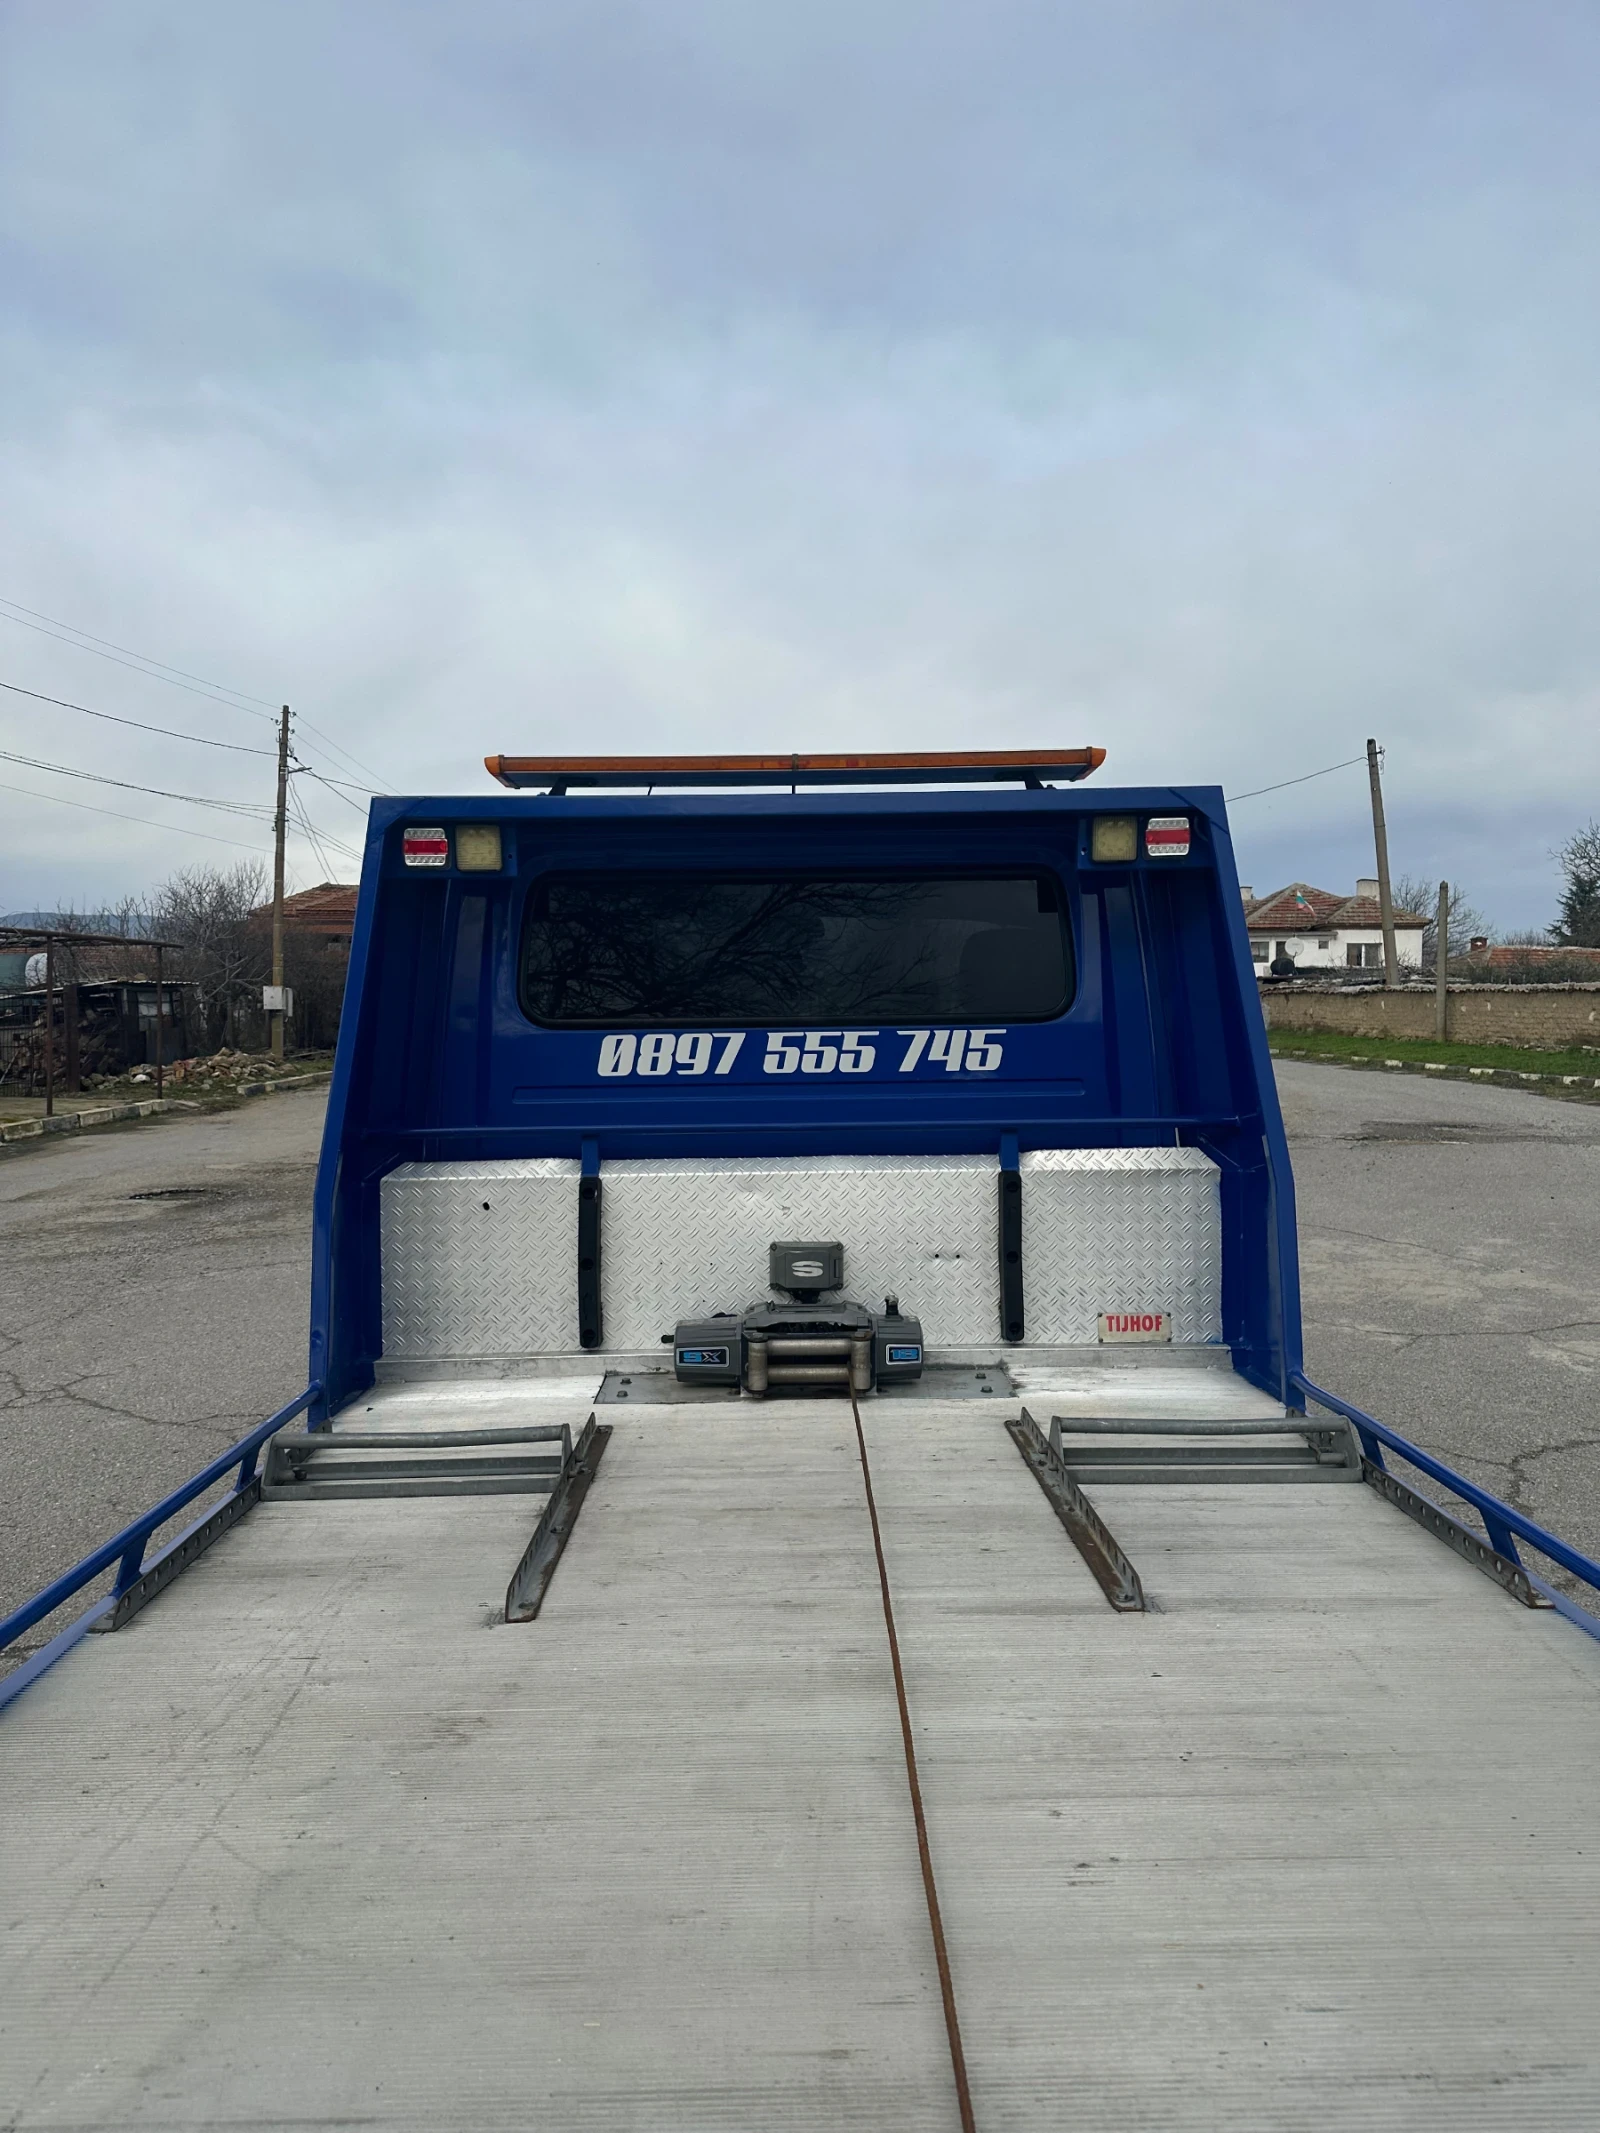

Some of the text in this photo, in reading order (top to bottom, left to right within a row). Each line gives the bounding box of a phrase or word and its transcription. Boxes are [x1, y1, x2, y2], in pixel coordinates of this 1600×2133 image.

[597, 1029, 1007, 1076] 0897 555 745
[791, 1260, 824, 1278] S
[1106, 1314, 1163, 1333] TIJHOF
[683, 1351, 721, 1363] SX
